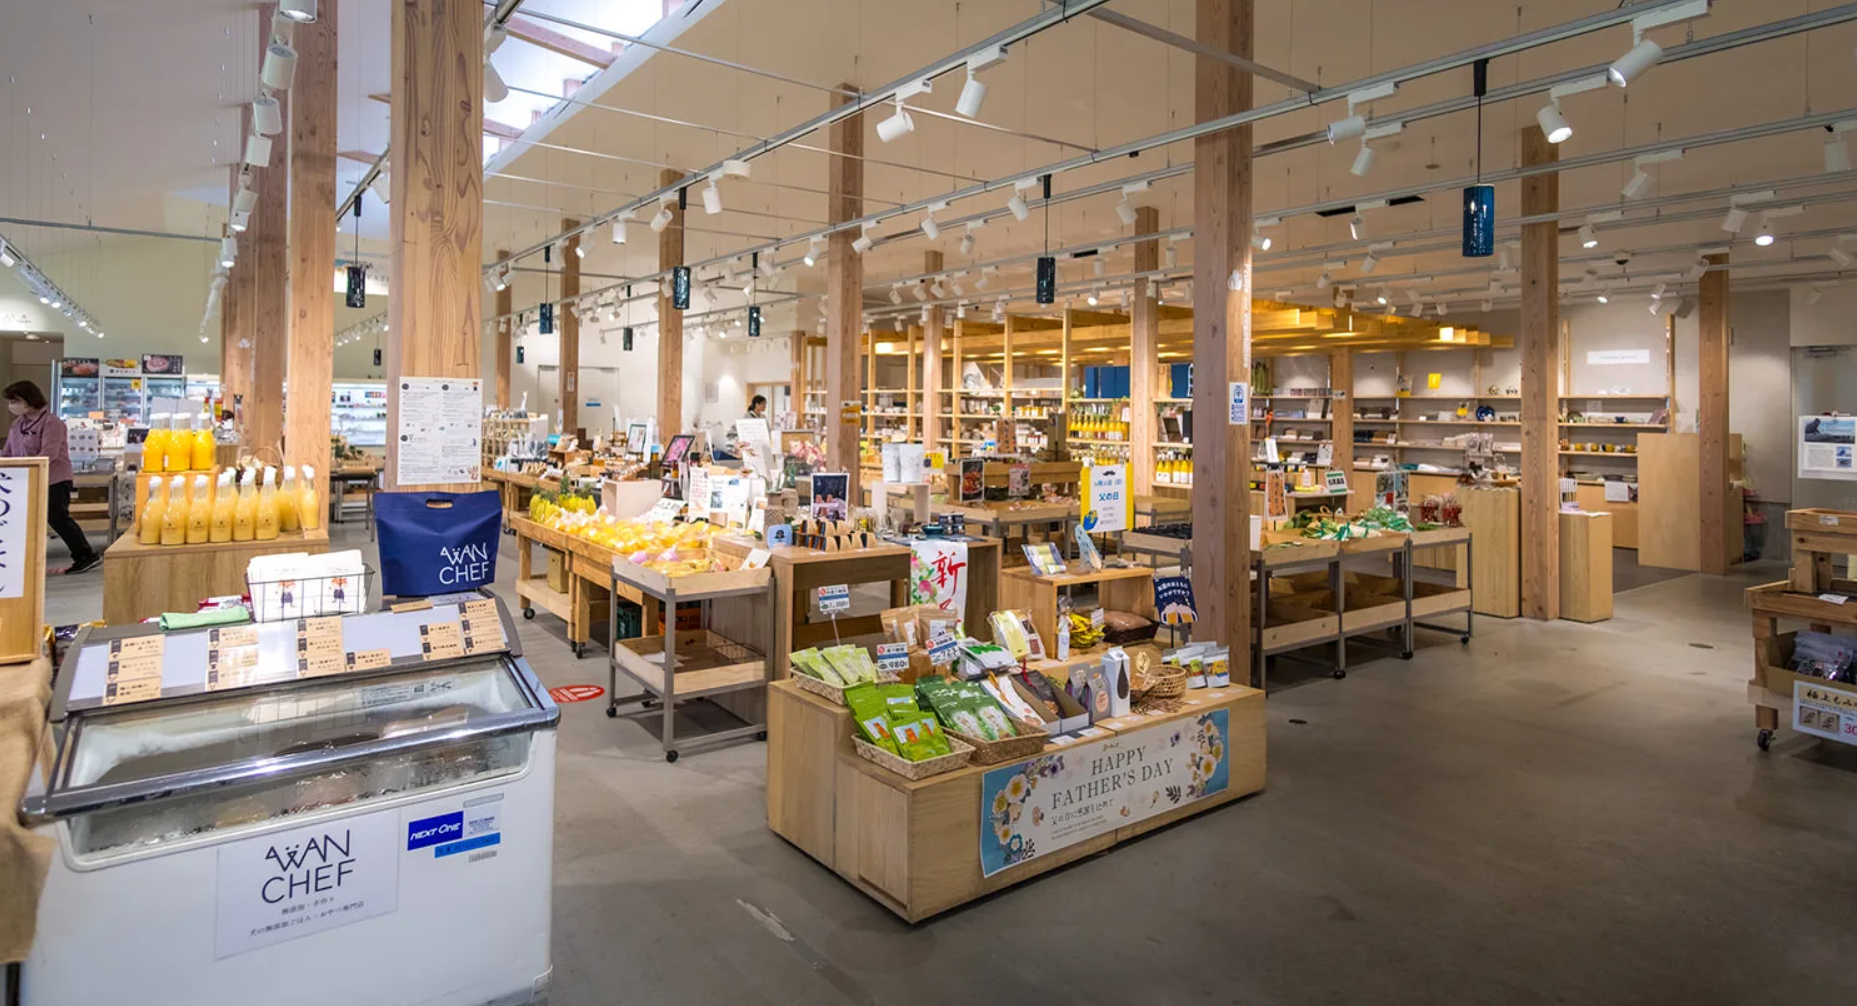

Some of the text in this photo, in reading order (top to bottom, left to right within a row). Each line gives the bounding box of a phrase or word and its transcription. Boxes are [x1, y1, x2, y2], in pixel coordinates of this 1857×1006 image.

[1098, 491, 1120, 502] 父の日
[439, 561, 489, 585] CHEF
[1091, 746, 1147, 777] HAPPY
[1051, 758, 1174, 811] FATHER'S DAY
[410, 828, 438, 841] NEXT
[438, 822, 461, 834] ONE
[261, 858, 356, 904] CHEF
